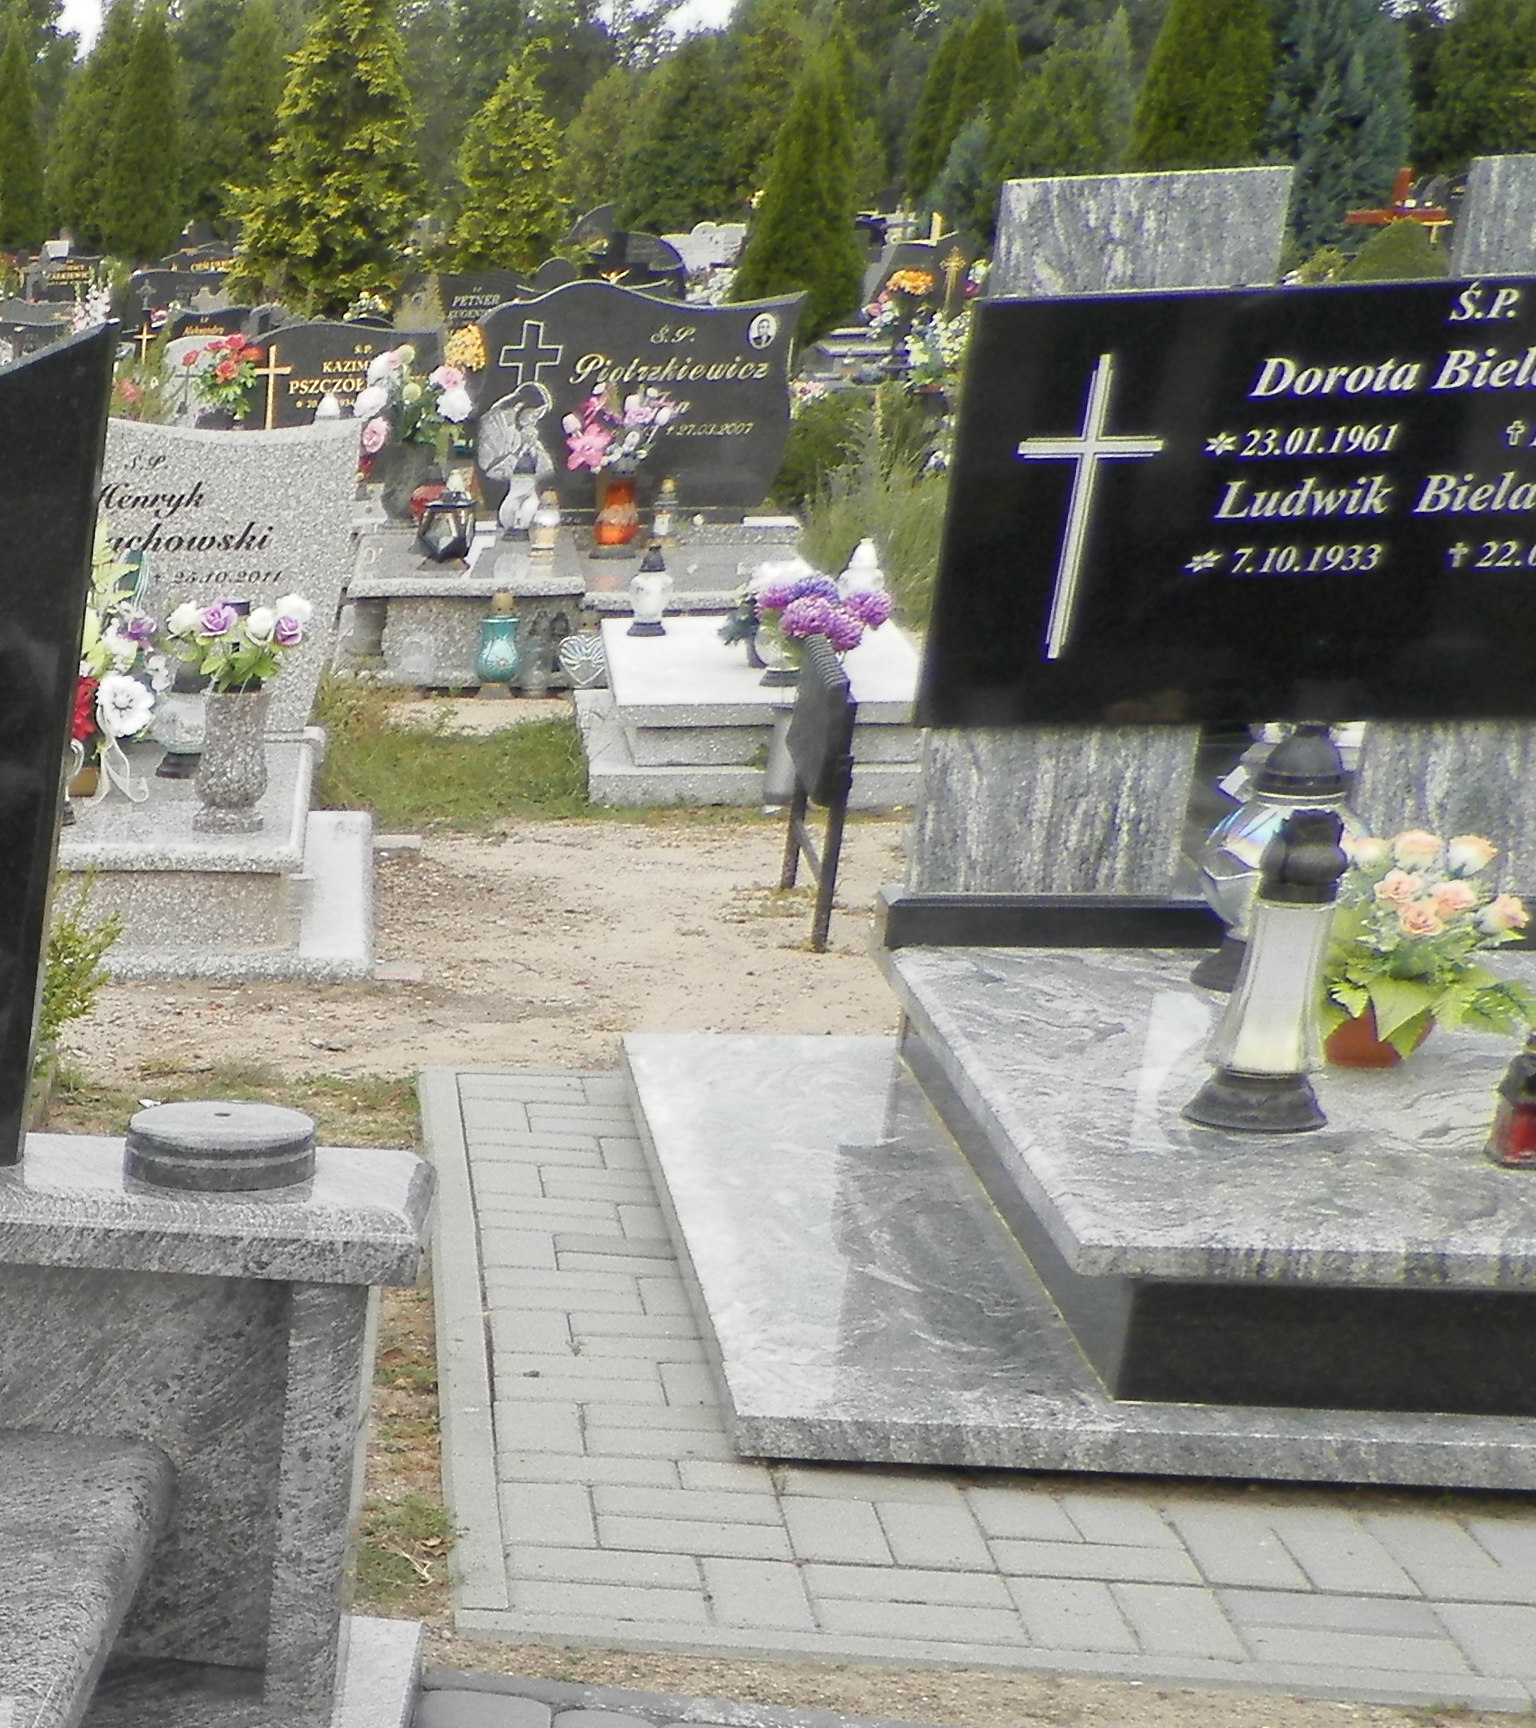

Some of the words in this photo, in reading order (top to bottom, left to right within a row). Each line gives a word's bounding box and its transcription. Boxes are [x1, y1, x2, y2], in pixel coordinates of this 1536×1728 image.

[1449, 281, 1520, 321] Ś.P.
[289, 374, 365, 394] PSZCZÓŁ
[569, 352, 771, 384] Piotrzkiewicz
[1250, 357, 1425, 398] Dorota
[1431, 346, 1536, 389] Biel
[1240, 423, 1400, 457] 23.01.1961
[99, 481, 204, 518] Henryk
[1215, 475, 1394, 519] Ludwik
[1231, 543, 1383, 575] 7.10.1933
